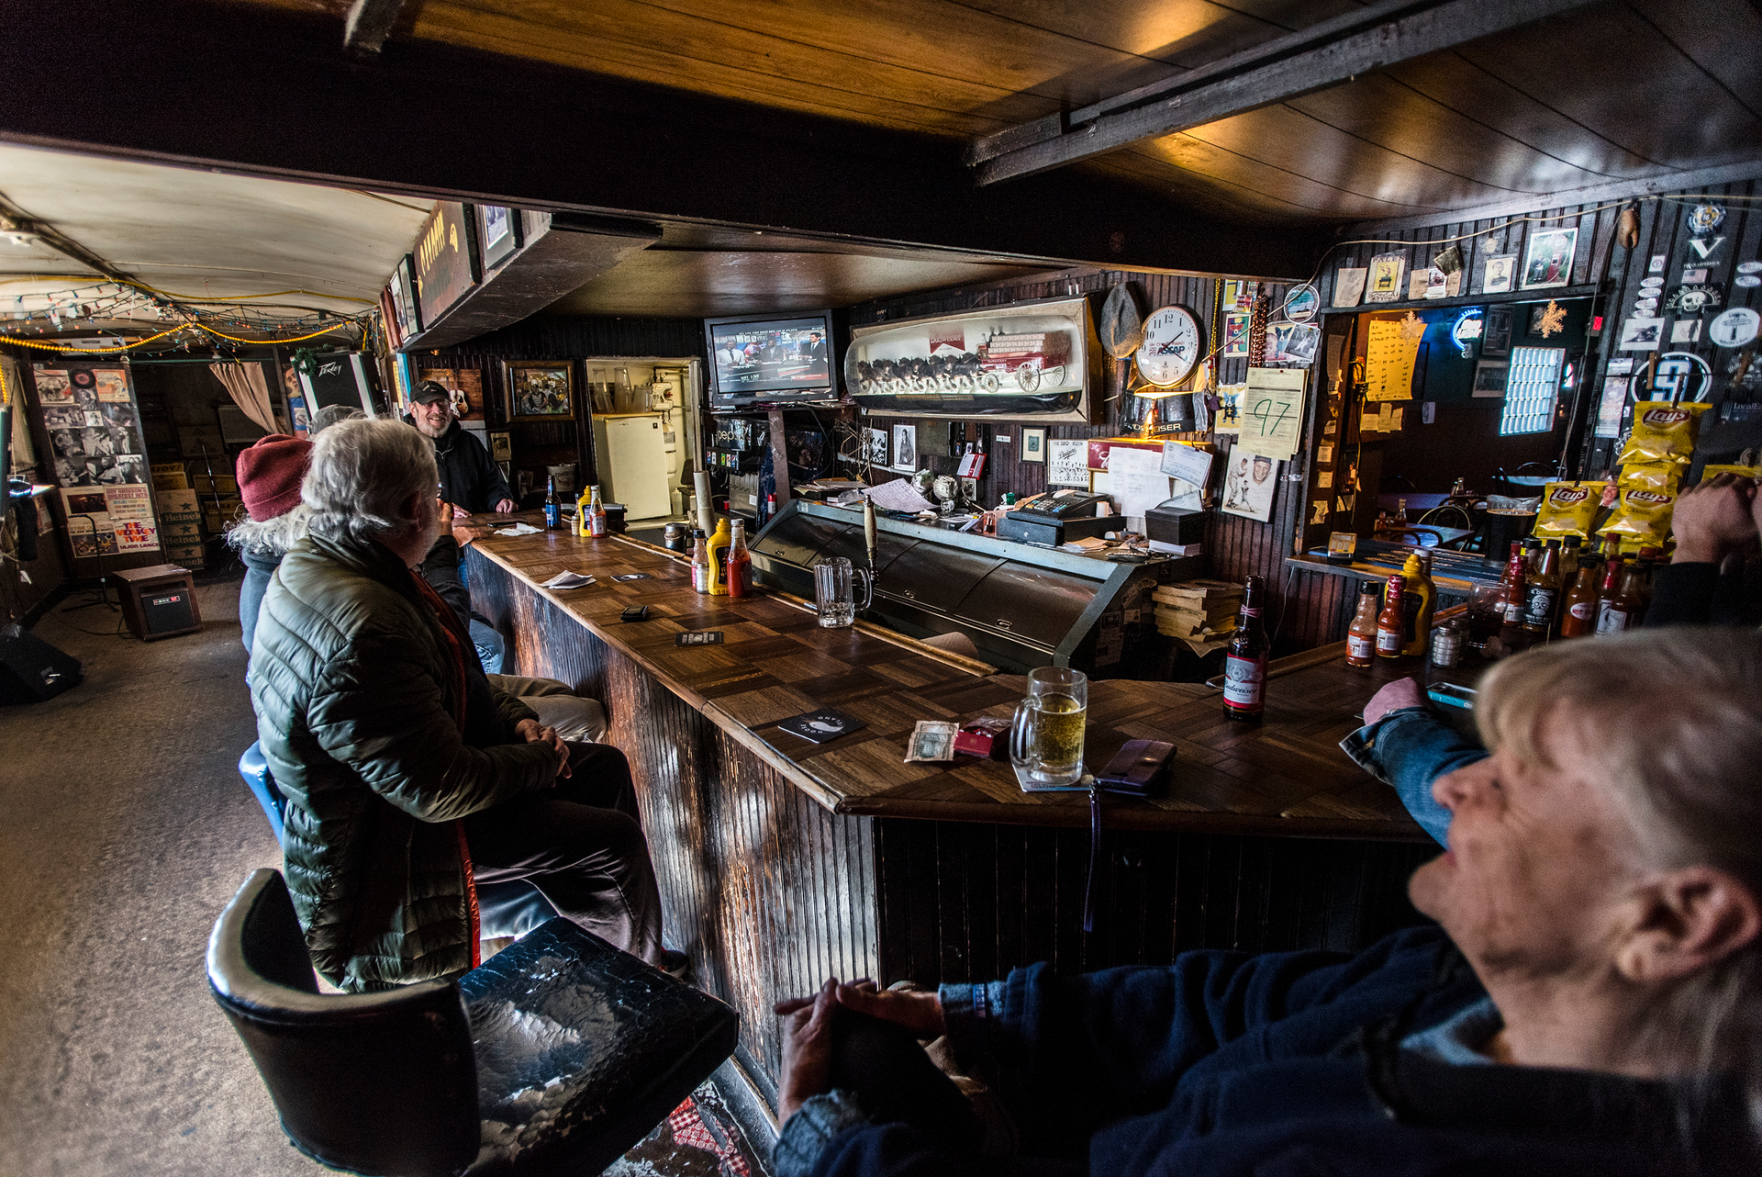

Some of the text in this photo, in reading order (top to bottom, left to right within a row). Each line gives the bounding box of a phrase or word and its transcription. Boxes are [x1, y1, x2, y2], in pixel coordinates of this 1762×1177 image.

[1689, 236, 1727, 259] V
[1157, 345, 1186, 356] ASCAP
[1734, 402, 1762, 411] LocalE
[1253, 398, 1292, 437] 97
[151, 463, 182, 473] NJOY!
[123, 521, 142, 530] THE
[171, 556, 204, 567] einek
